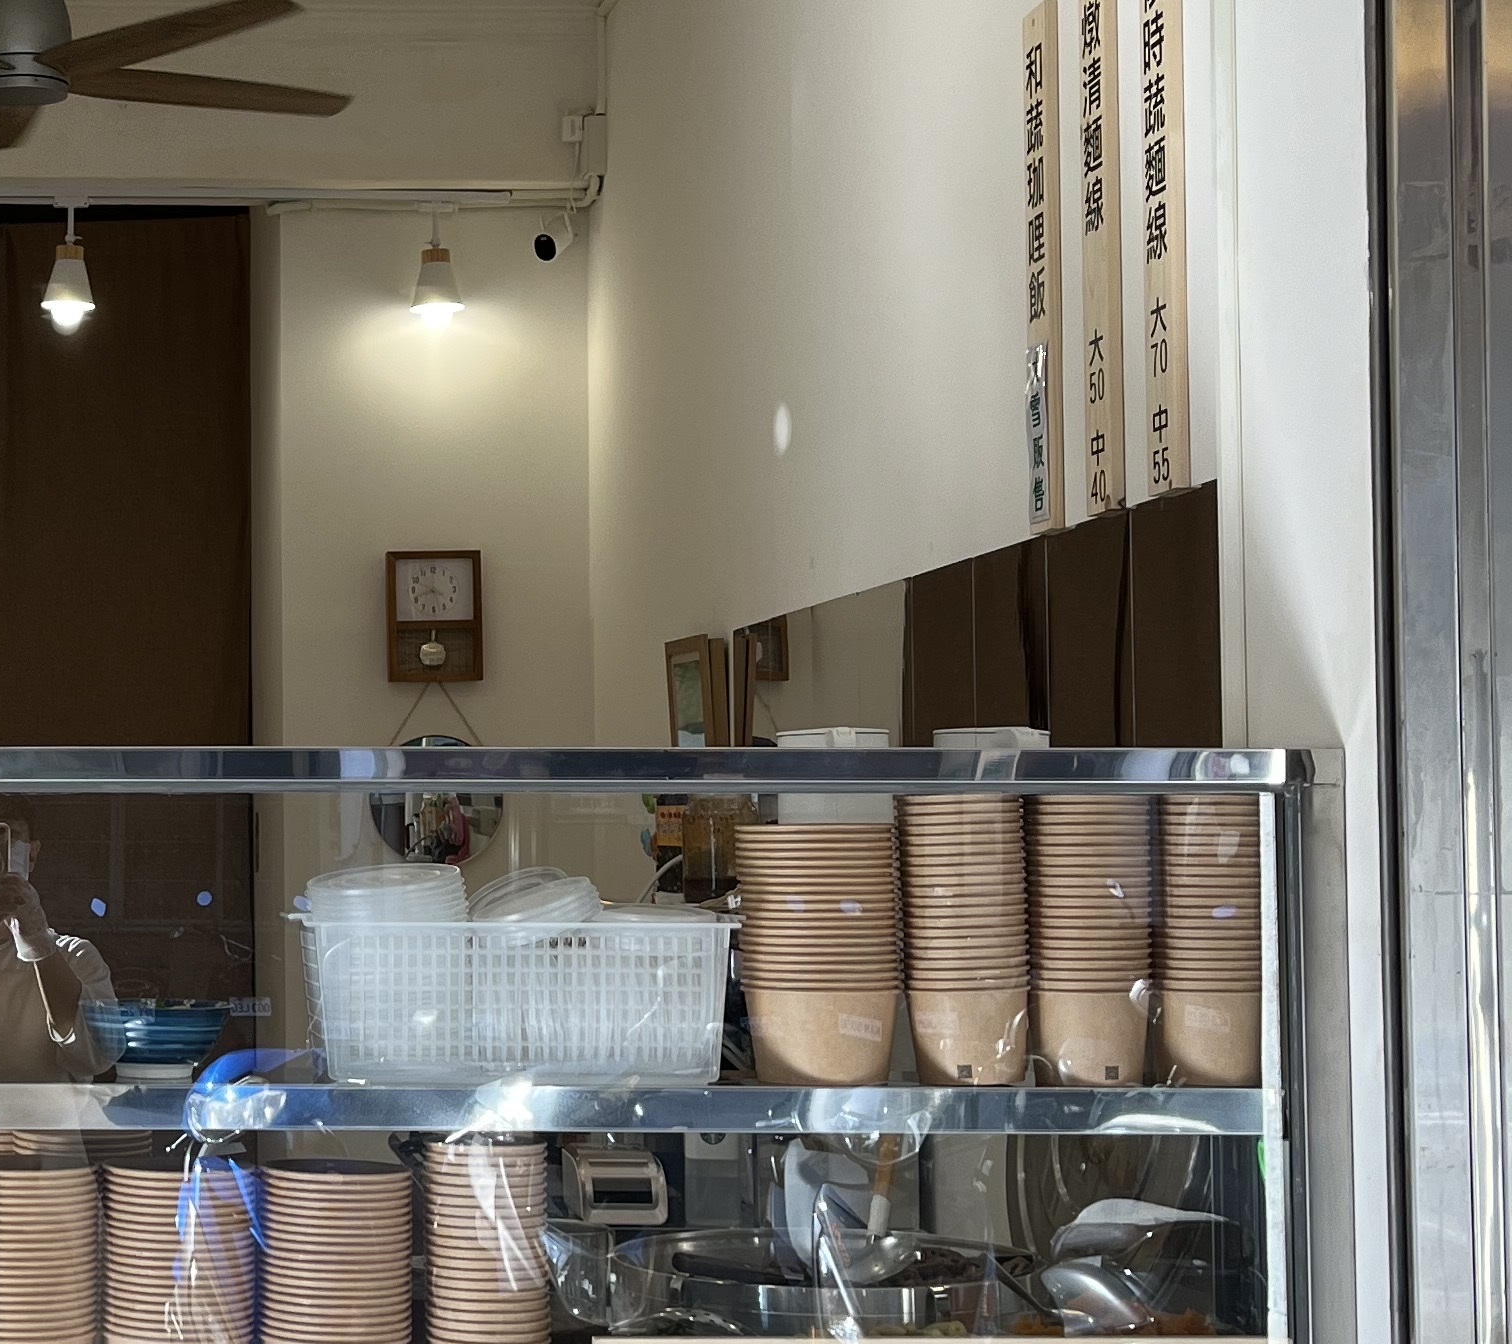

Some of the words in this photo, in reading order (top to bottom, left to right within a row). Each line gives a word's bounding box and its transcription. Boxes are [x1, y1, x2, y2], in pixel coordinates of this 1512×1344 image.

[1025, 42, 1046, 325] 和蔬珈哩飯
